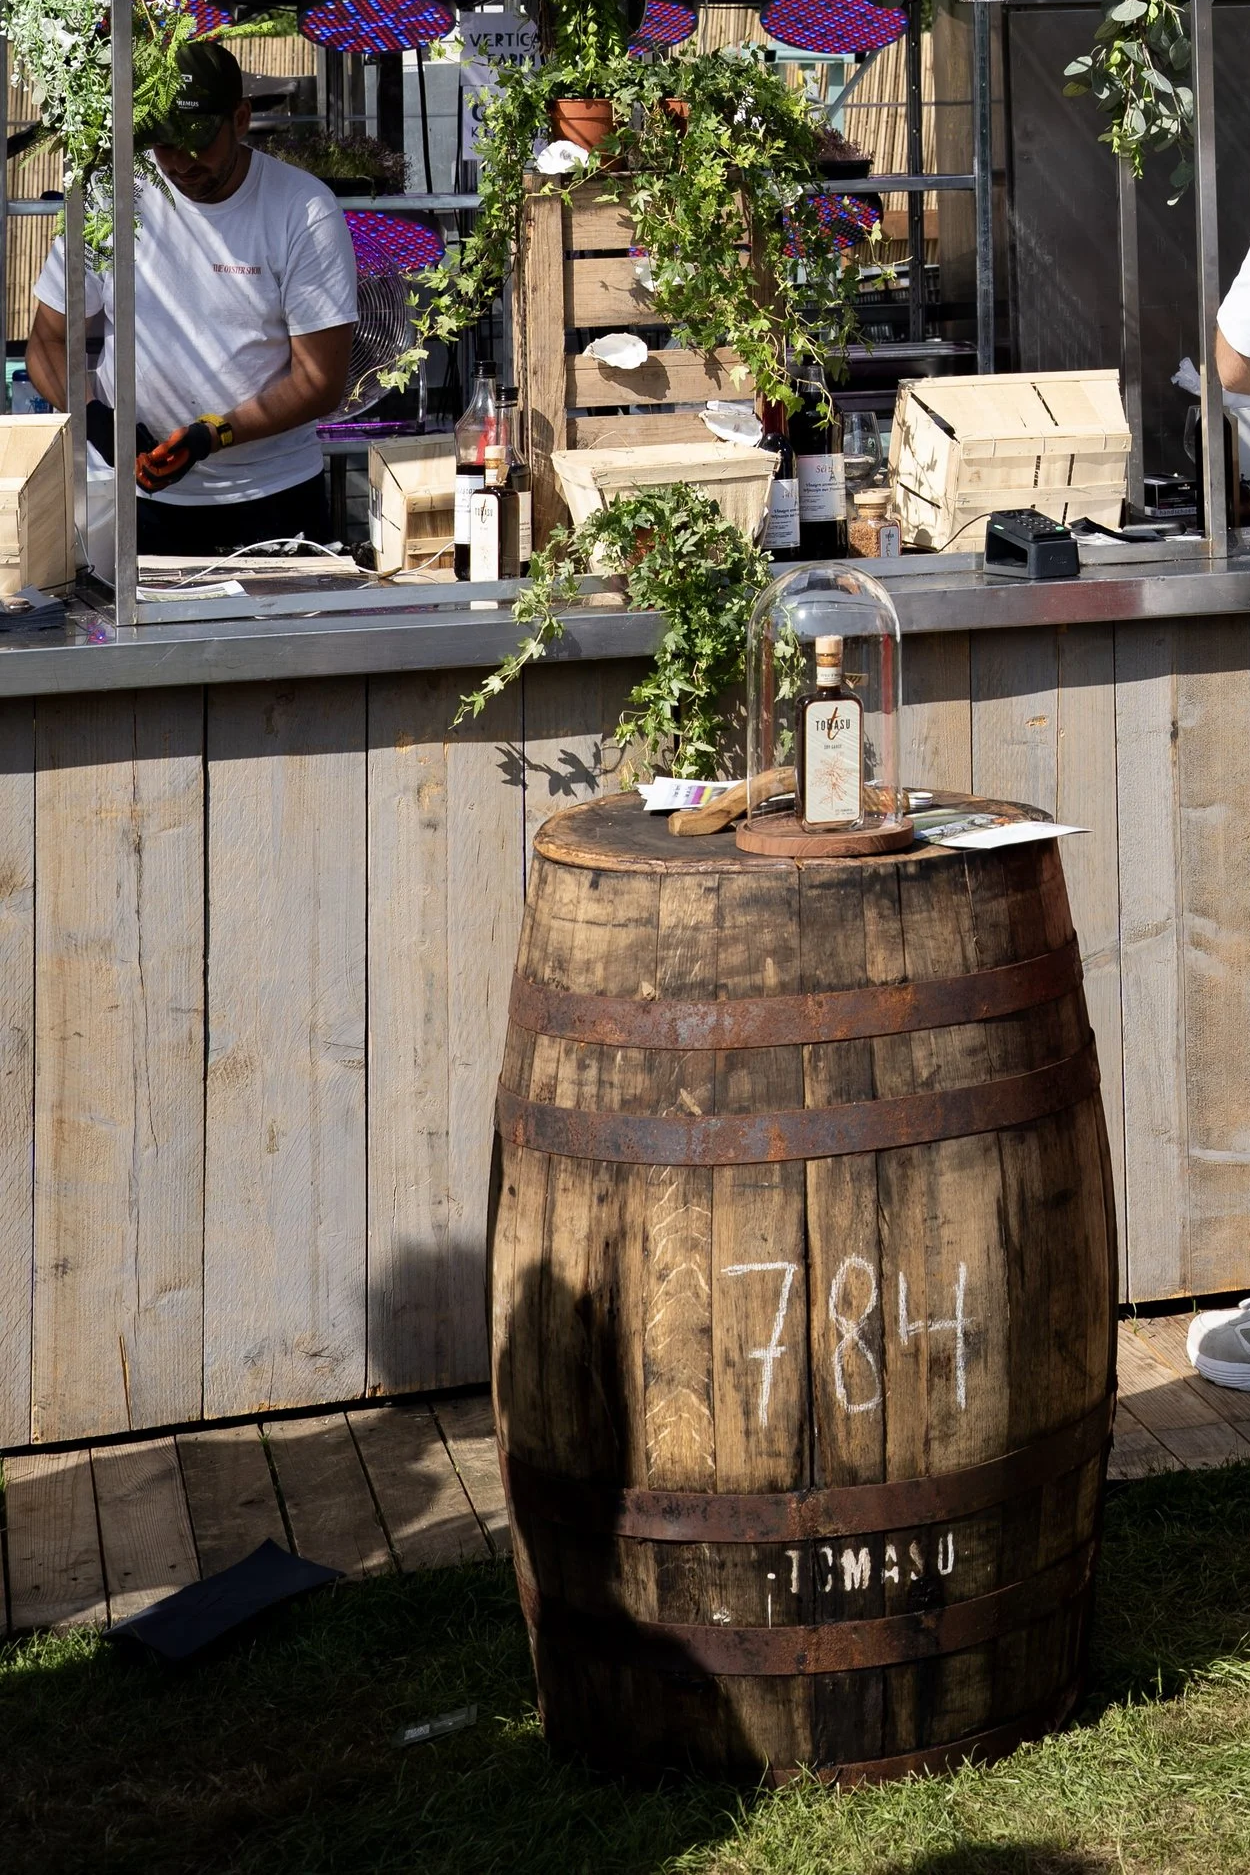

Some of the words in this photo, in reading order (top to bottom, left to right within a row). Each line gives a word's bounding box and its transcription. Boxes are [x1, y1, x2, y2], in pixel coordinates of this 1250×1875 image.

[212, 264, 224, 273] THE
[815, 718, 851, 732] TOMASU
[721, 1254, 975, 1429] 784
